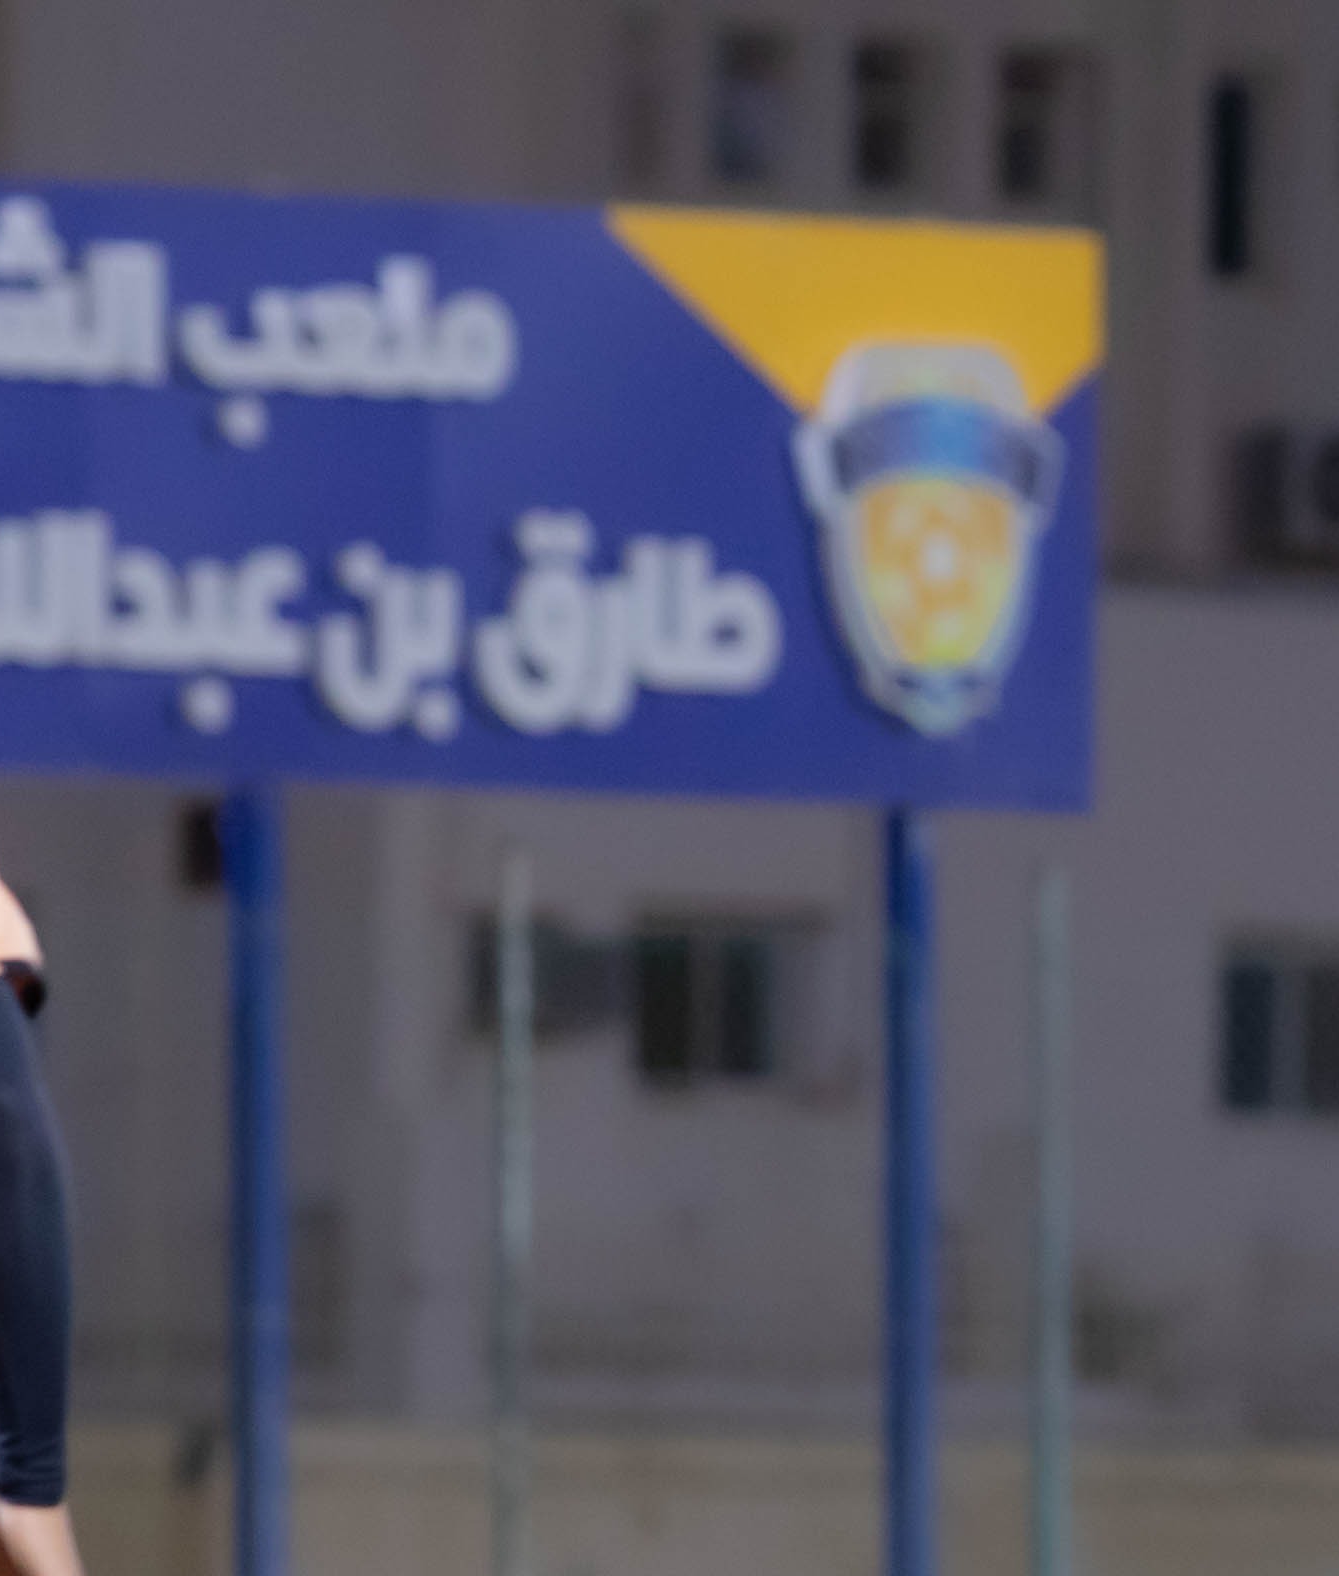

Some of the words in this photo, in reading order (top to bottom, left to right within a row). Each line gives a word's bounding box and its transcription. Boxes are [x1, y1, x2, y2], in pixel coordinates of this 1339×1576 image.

[178, 254, 518, 445] ملعب
[314, 543, 463, 740] بن
[471, 508, 783, 734] طارق
